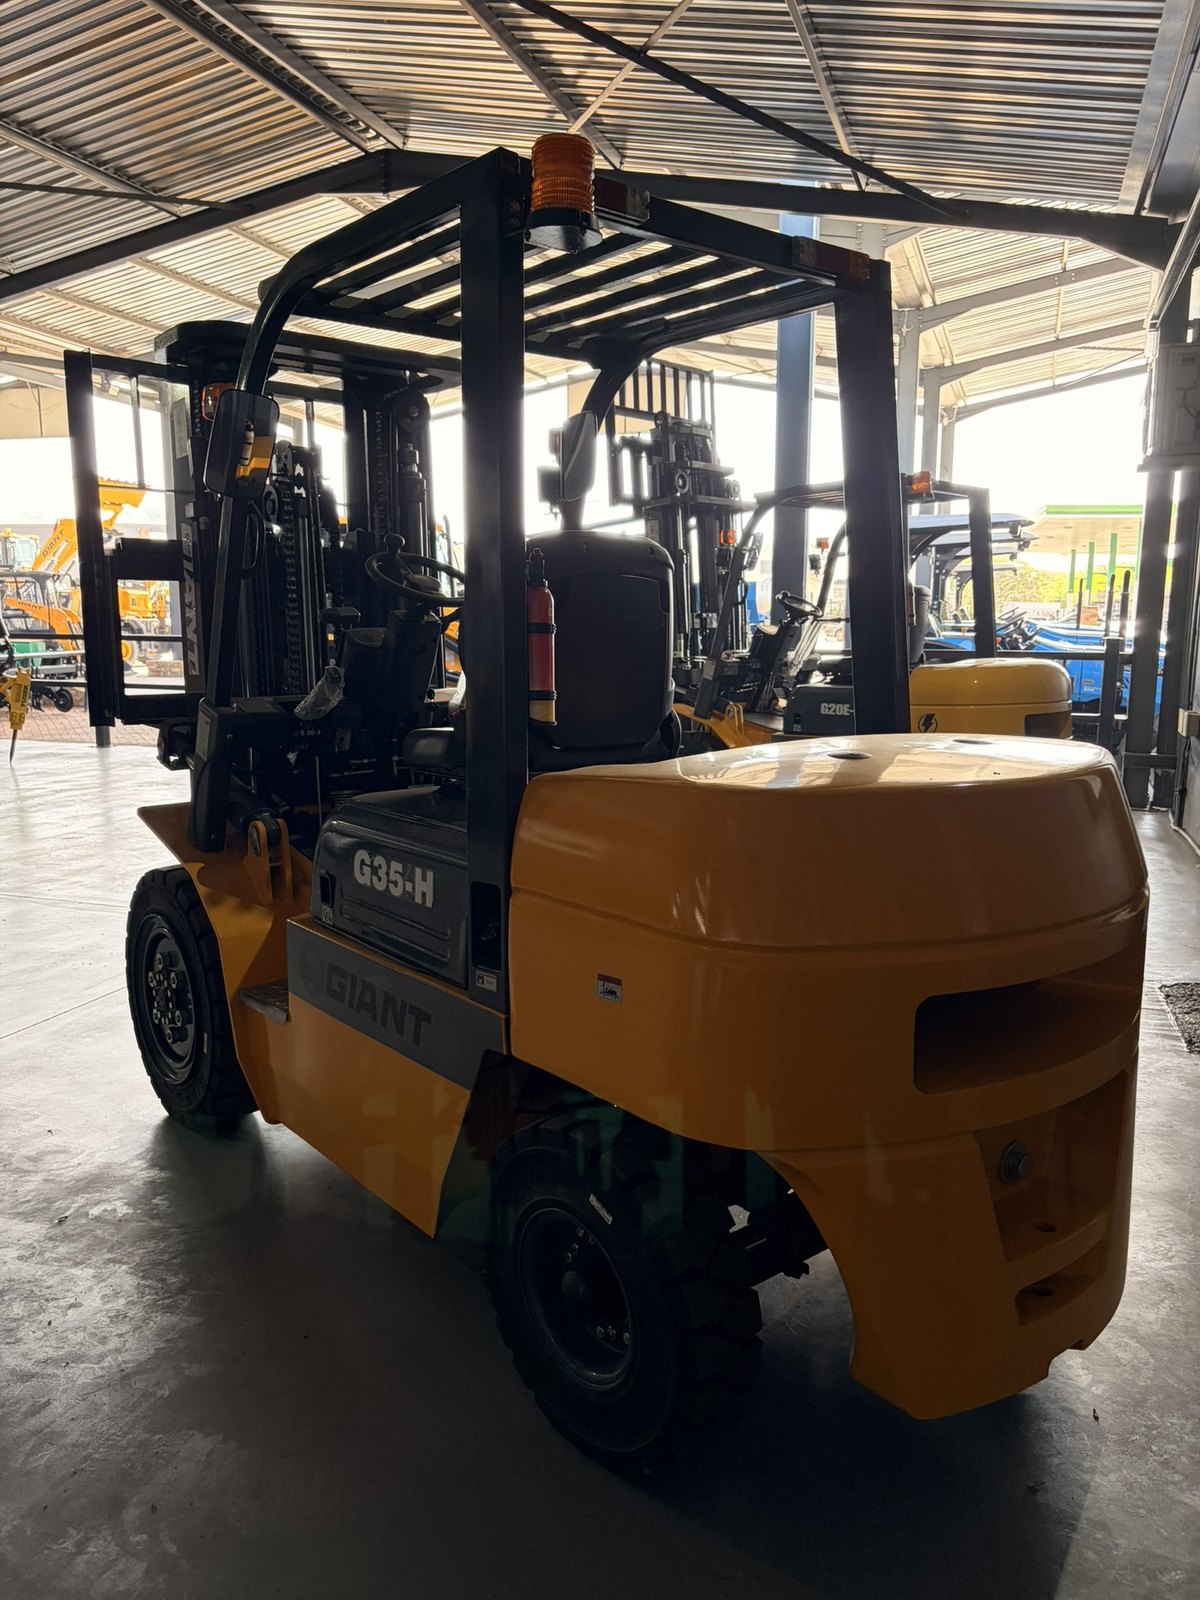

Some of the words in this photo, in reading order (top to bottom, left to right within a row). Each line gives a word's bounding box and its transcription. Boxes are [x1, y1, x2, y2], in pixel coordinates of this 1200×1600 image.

[42, 529, 64, 557] GIANT
[182, 522, 200, 676] GIANT
[353, 849, 434, 909] G35-H
[325, 962, 432, 1046] GIANT
